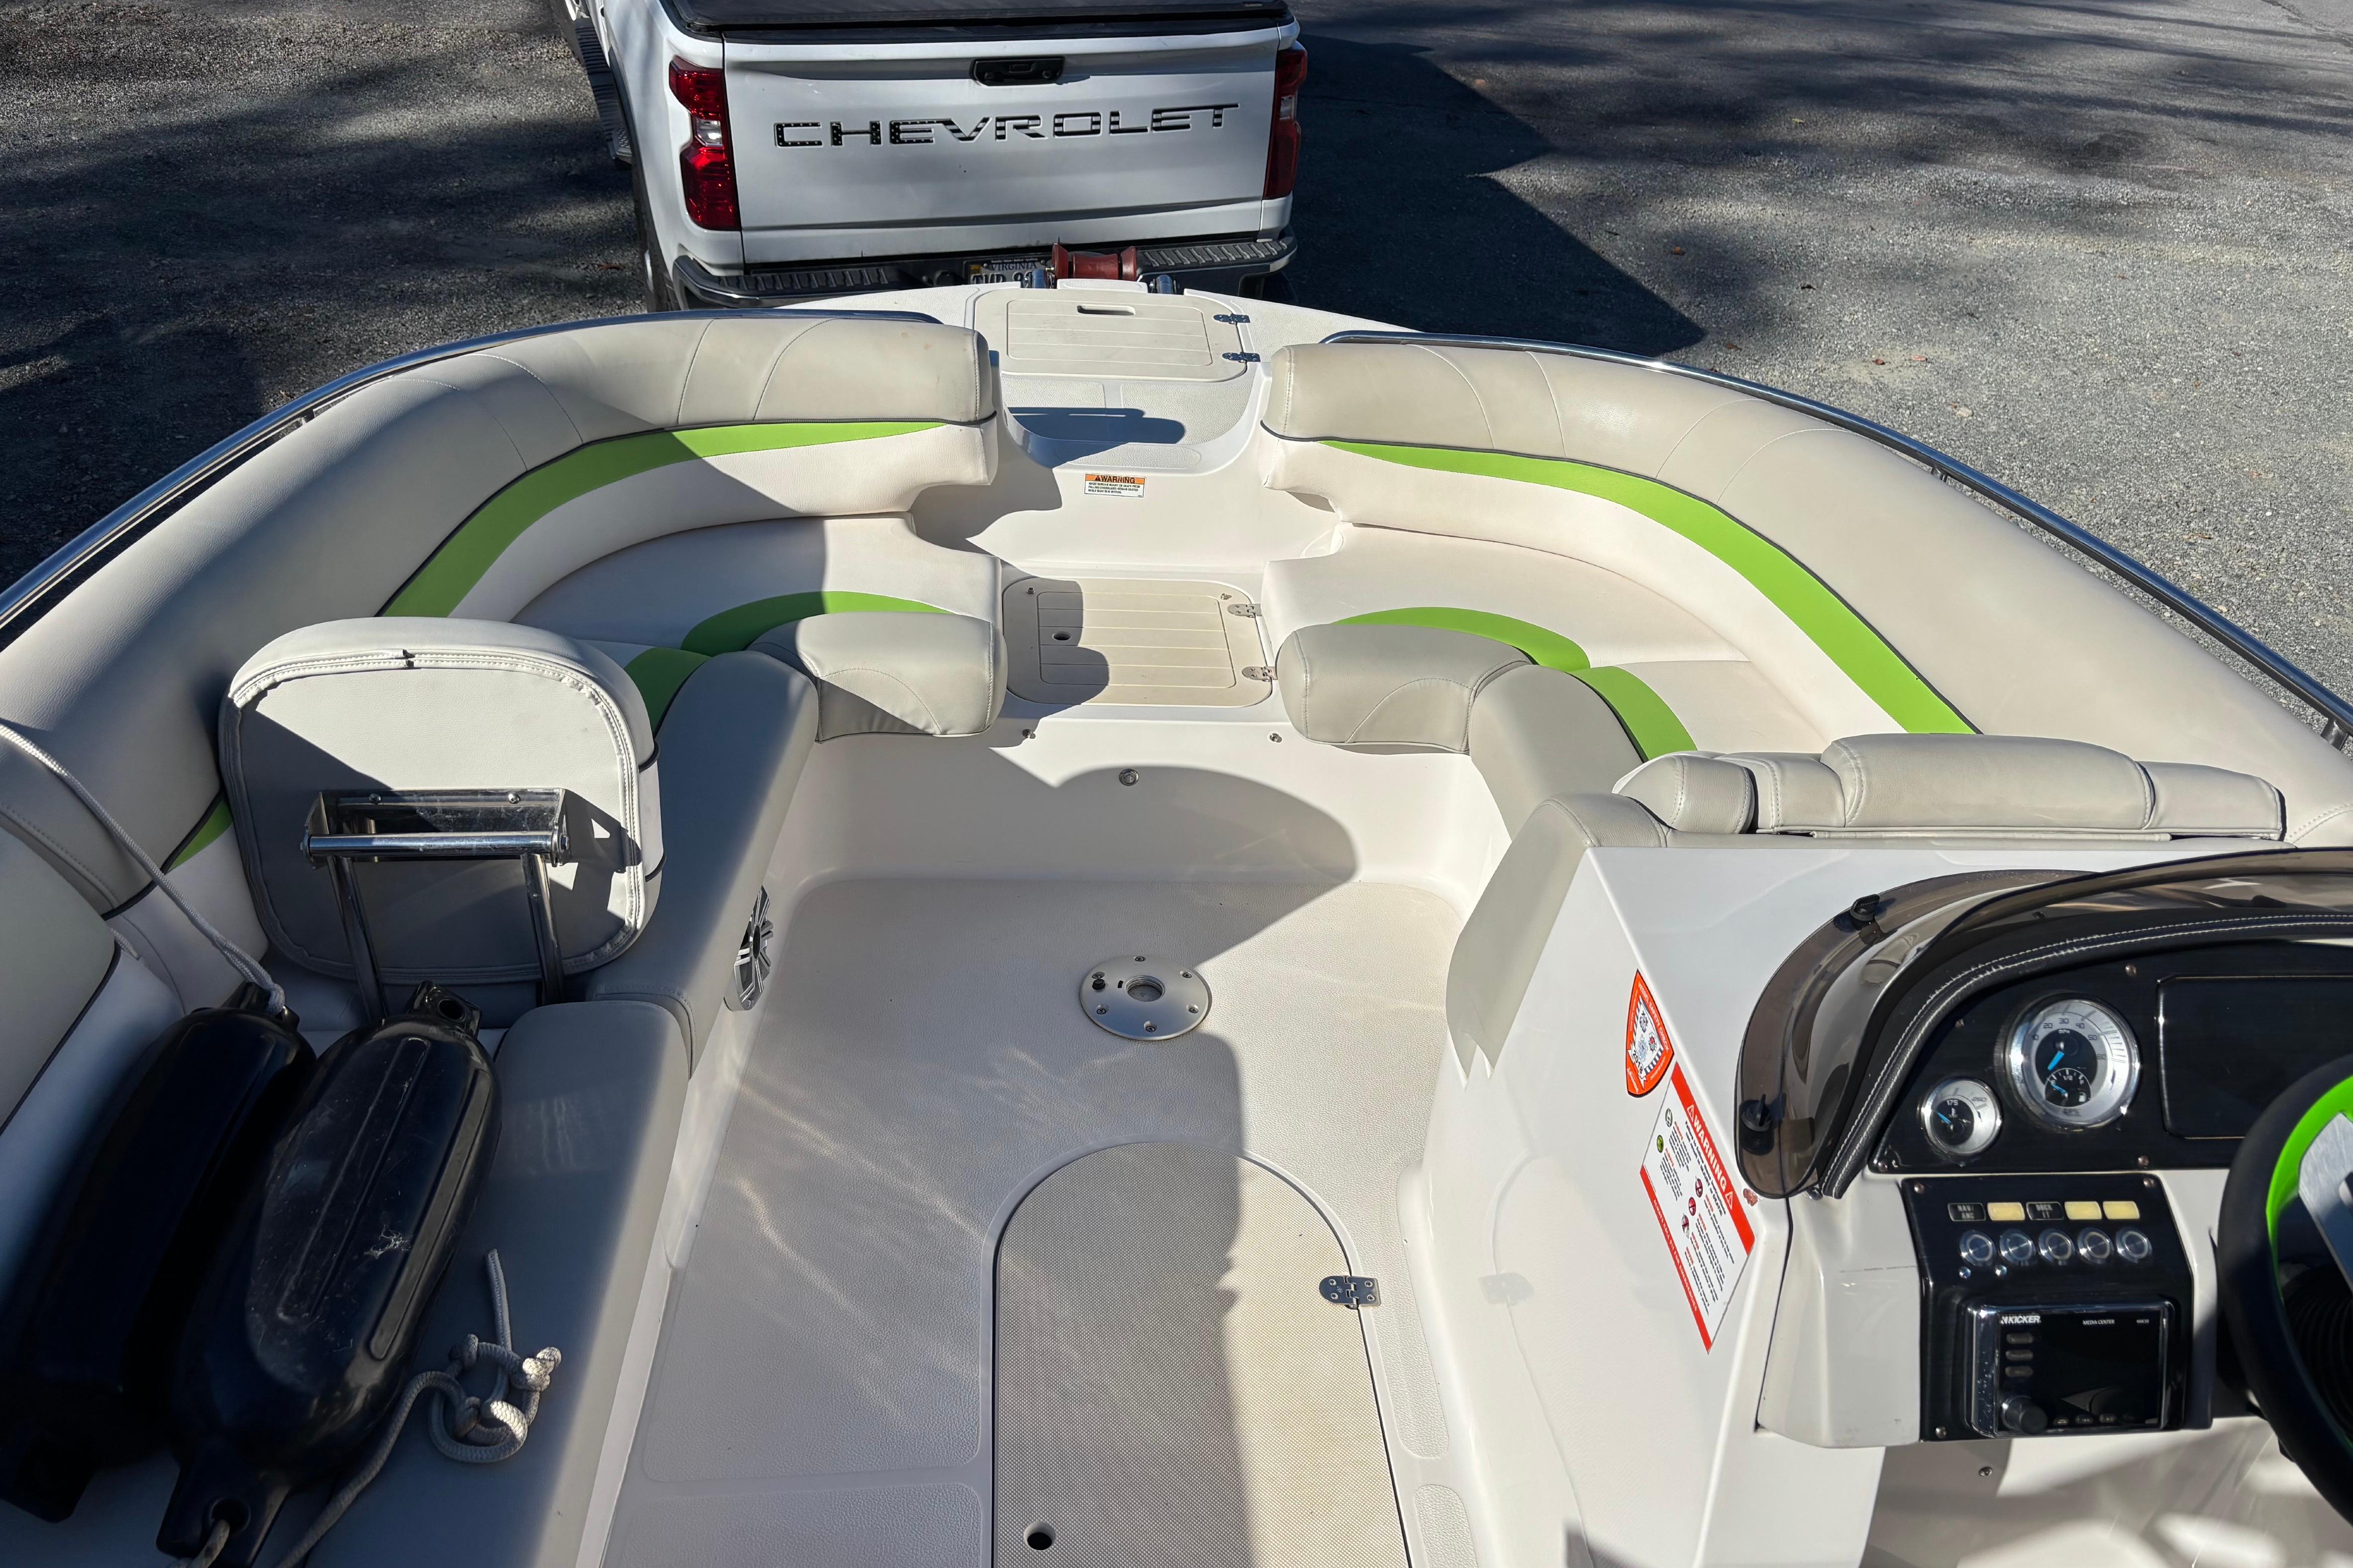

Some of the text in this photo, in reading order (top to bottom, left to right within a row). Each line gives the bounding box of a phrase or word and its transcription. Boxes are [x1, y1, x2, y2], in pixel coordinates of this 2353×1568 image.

[773, 103, 1239, 147] CHEVROLET
[991, 261, 1037, 271] VIRGINIA
[1102, 475, 1135, 484] WARNING
[1659, 1026, 1669, 1052] CHECK
[1633, 1050, 1643, 1074] 2018
[1693, 1114, 1727, 1192] WARNING
[1653, 1199, 1663, 1223] ALWAYS
[1679, 1264, 1697, 1312] EMERGENCIES
